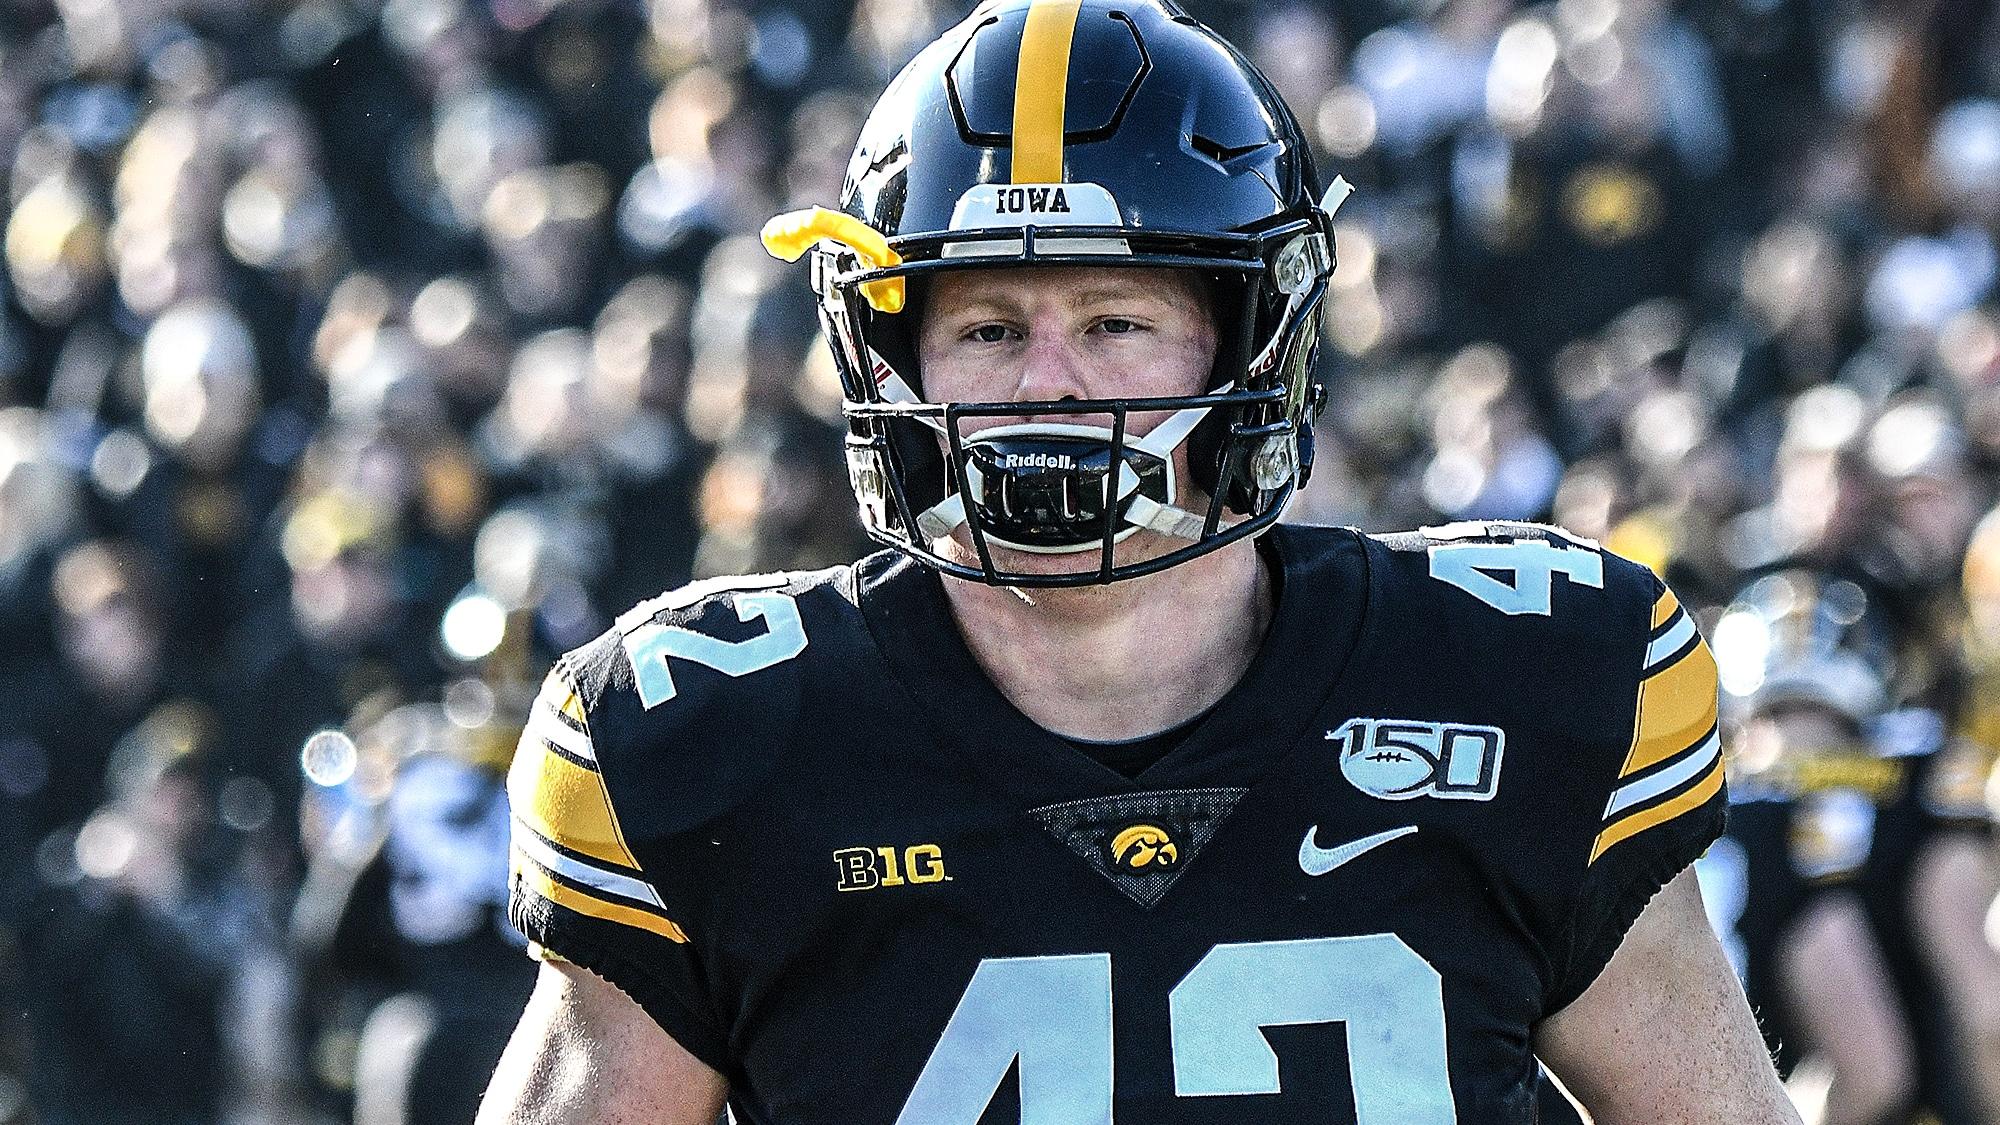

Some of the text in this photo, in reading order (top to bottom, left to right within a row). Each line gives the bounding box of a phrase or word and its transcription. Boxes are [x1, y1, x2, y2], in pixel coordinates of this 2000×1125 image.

[996, 188, 1071, 213] IOWA
[1419, 520, 1604, 616] 4
[616, 573, 809, 711] 2
[1326, 718, 1505, 800] 150
